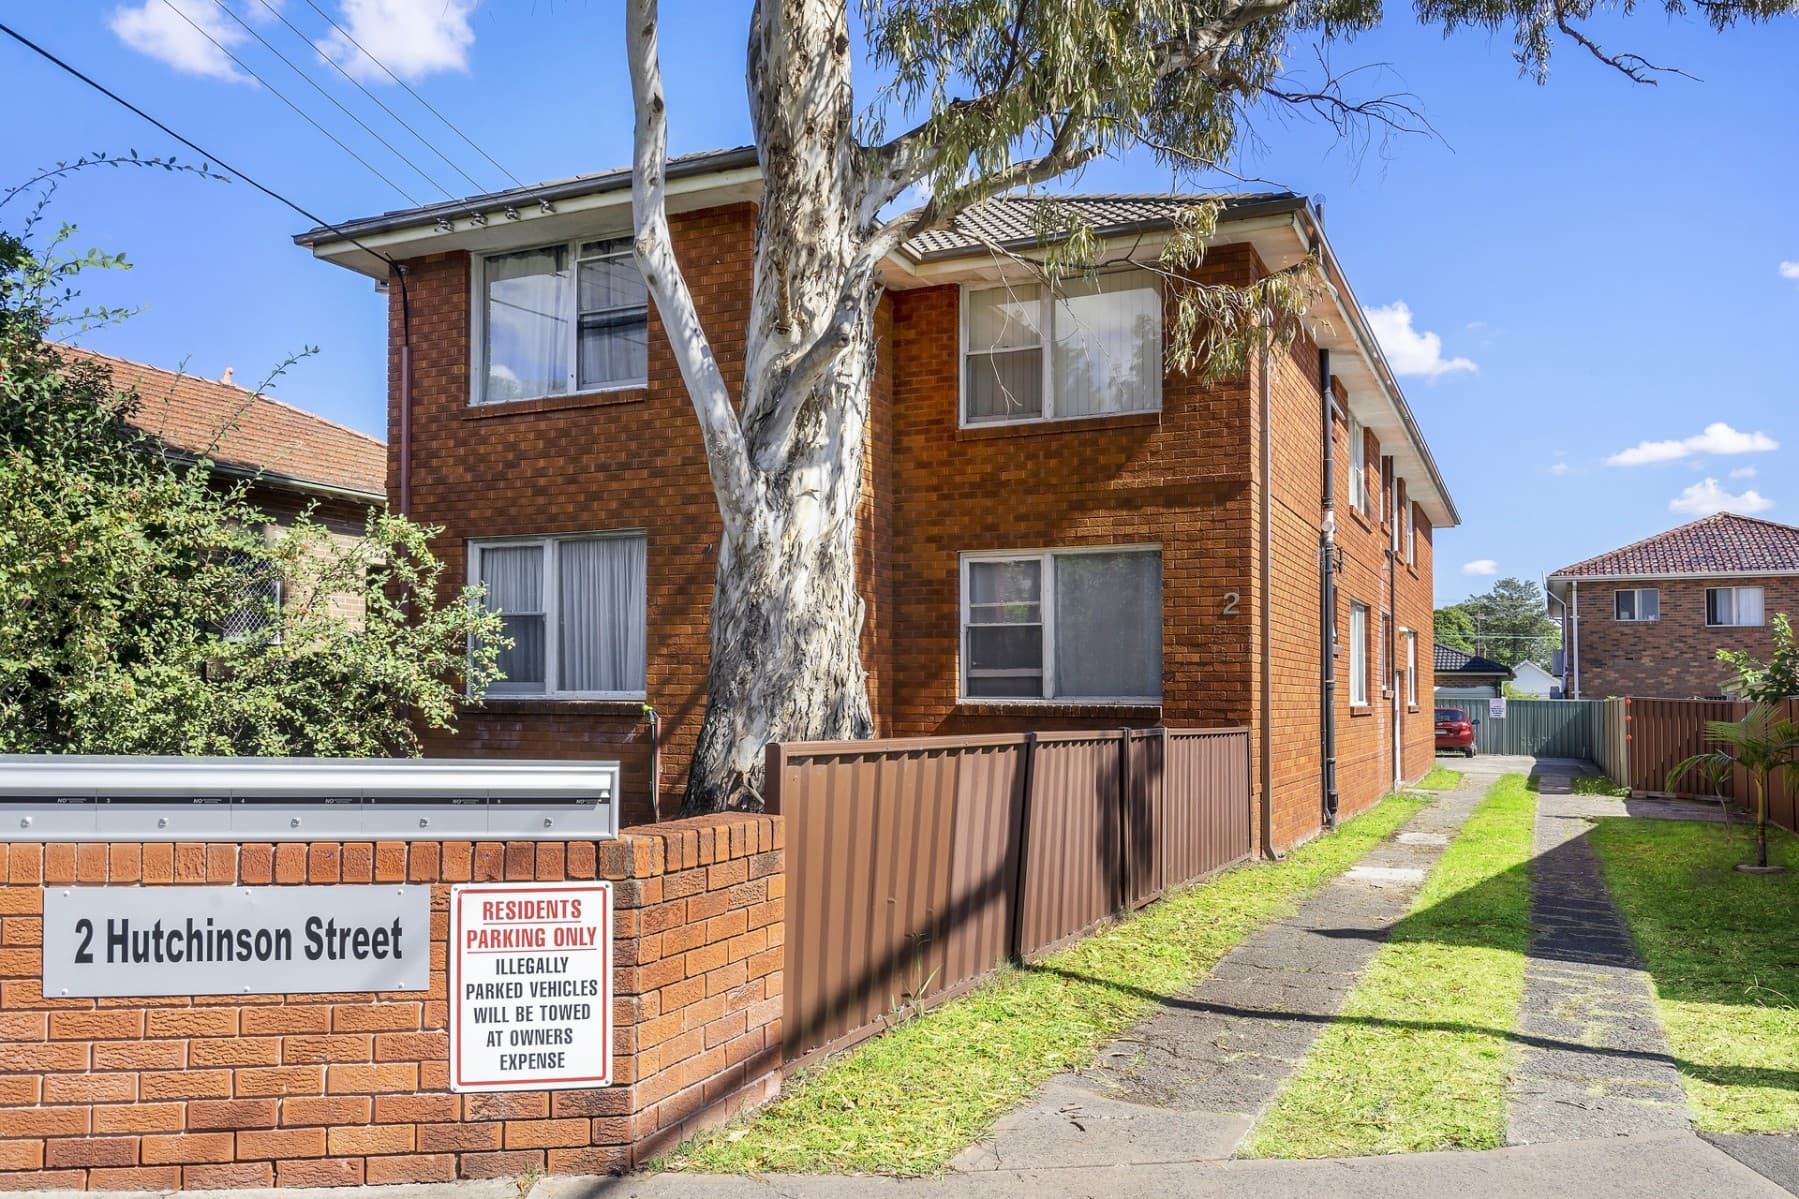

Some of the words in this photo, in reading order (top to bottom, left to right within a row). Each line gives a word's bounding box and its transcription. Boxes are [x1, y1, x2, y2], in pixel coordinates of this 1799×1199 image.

[1223, 592, 1241, 615] 2
[482, 899, 582, 921] RESIDENTS
[74, 918, 94, 964] 2
[106, 917, 293, 964] Hutchinson
[304, 915, 403, 961] Street
[466, 927, 546, 949] PARKING
[553, 926, 597, 947] ONLY
[495, 956, 569, 975] ILLEGALLY
[466, 982, 523, 1000] PARKED
[530, 979, 598, 998] VEHICLES
[474, 1006, 509, 1024] WILL
[515, 1005, 534, 1022] BE
[540, 1003, 591, 1022] TOWED
[486, 1030, 504, 1047] AT
[510, 1028, 573, 1047] OWNERS
[500, 1052, 565, 1071] EXPENSE
